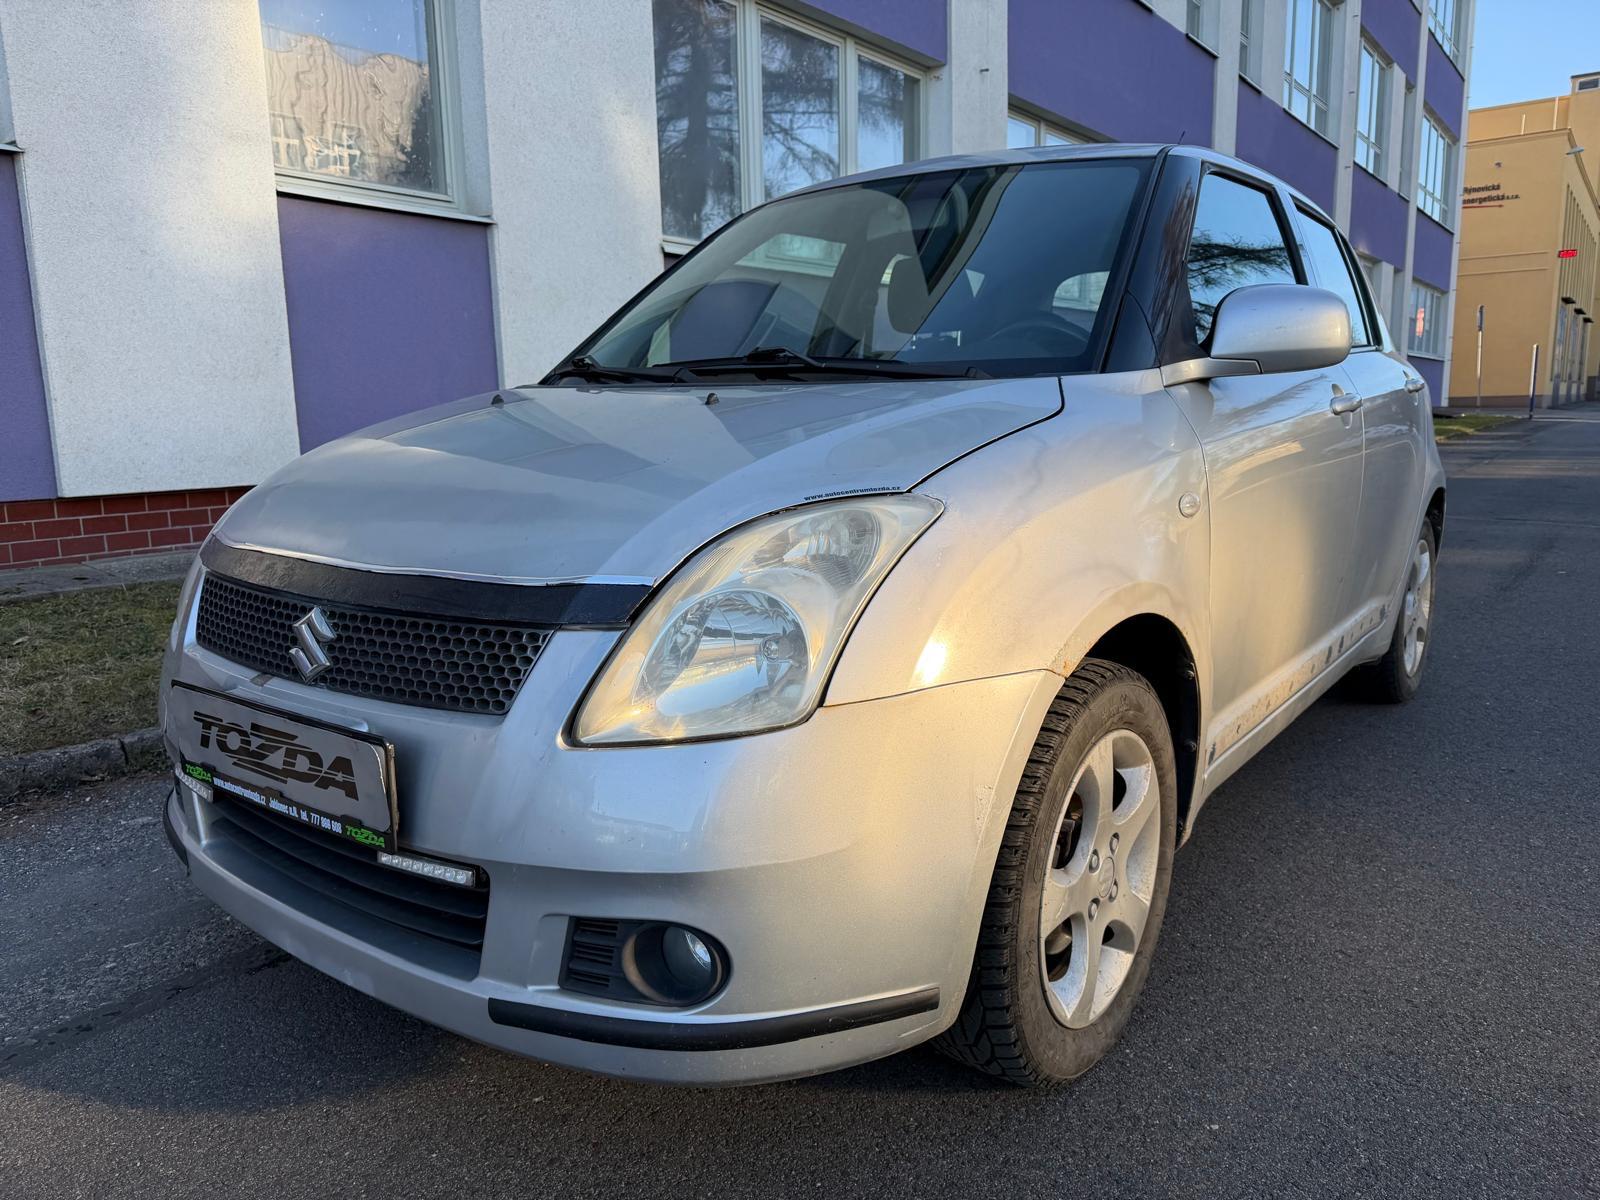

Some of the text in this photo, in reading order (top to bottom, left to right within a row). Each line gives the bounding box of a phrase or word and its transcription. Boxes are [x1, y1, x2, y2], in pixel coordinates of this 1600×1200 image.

[193, 710, 360, 801] TOZDA
[185, 763, 213, 783] TOZDA
[345, 825, 386, 849] TOZDA
